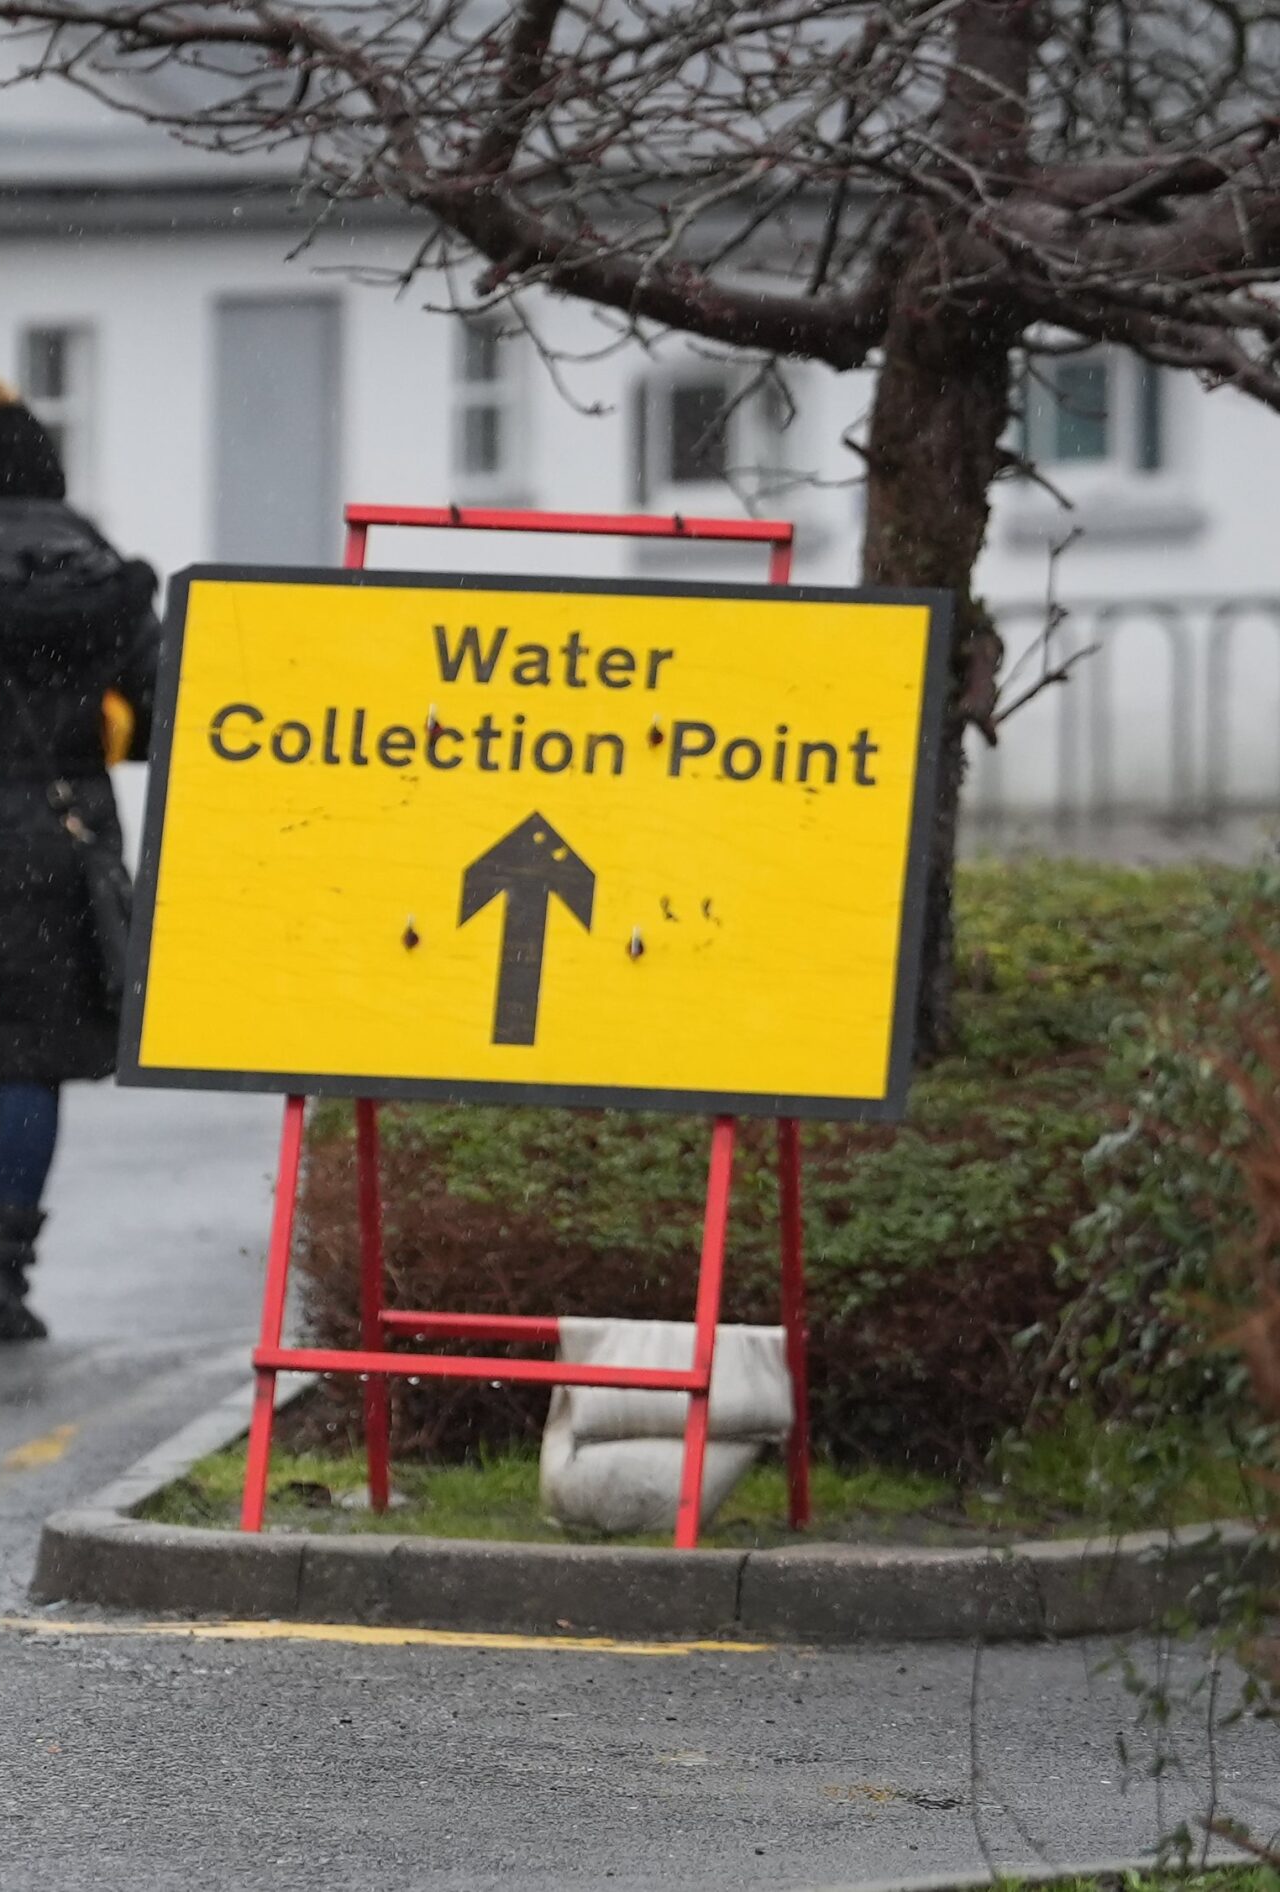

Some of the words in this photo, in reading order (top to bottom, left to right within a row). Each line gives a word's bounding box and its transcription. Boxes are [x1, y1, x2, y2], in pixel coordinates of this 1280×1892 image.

[434, 626, 674, 689] Water
[209, 703, 625, 775] Collection
[668, 720, 879, 787] Point
